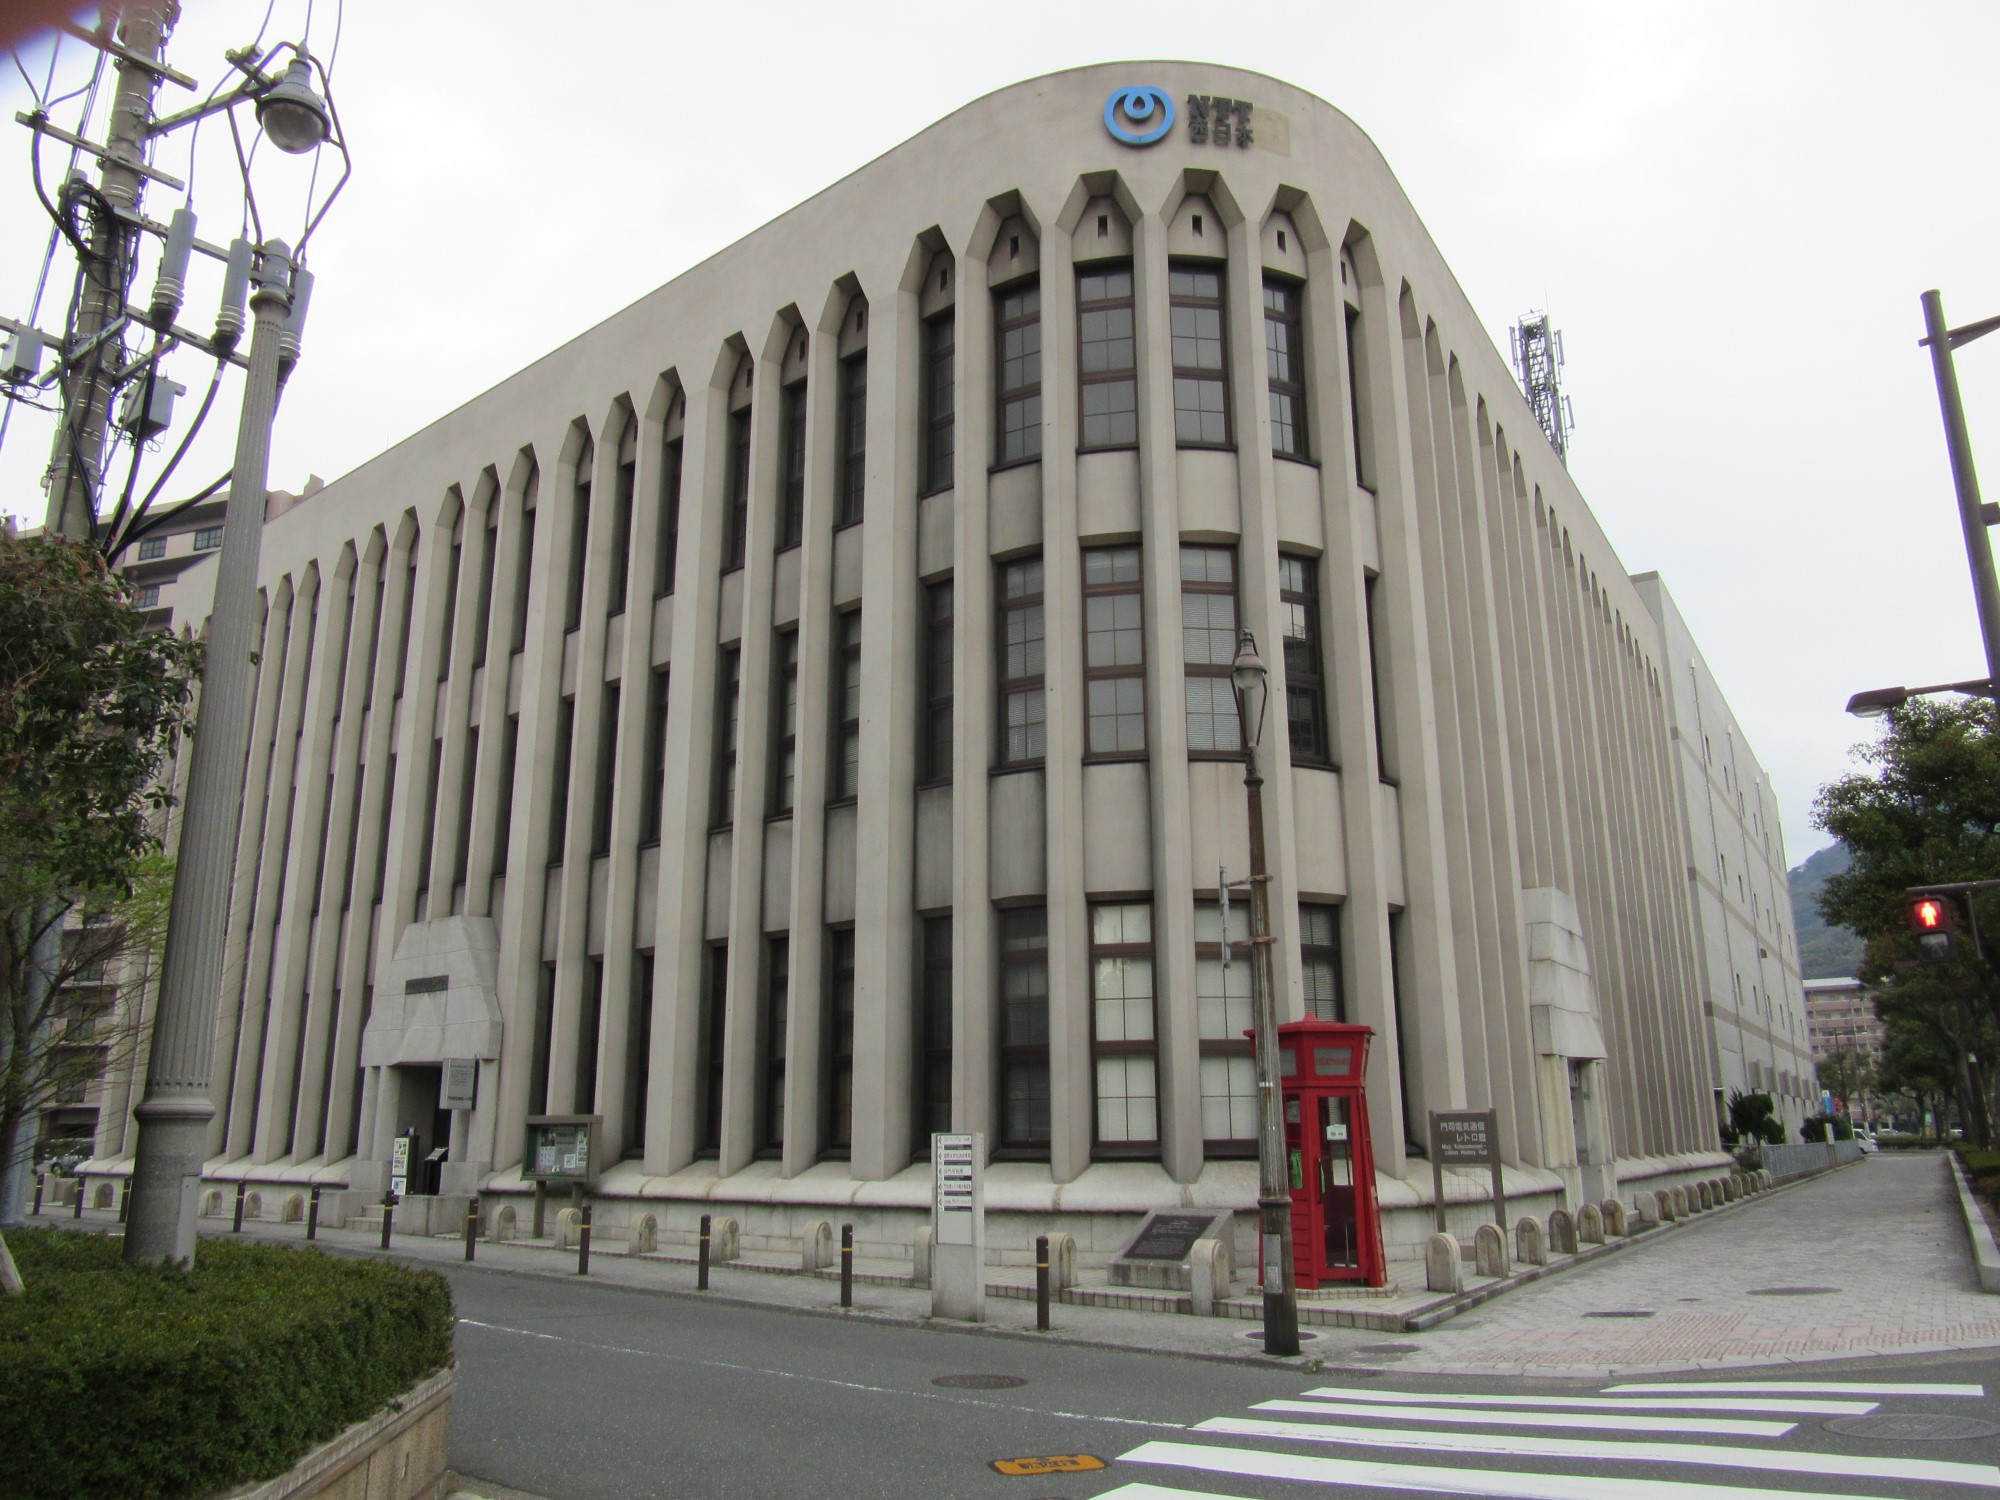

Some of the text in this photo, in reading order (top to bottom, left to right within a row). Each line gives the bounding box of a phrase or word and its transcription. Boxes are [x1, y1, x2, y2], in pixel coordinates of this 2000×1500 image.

[1188, 94, 1253, 122] NTT
[1189, 119, 1254, 148] 西日本
